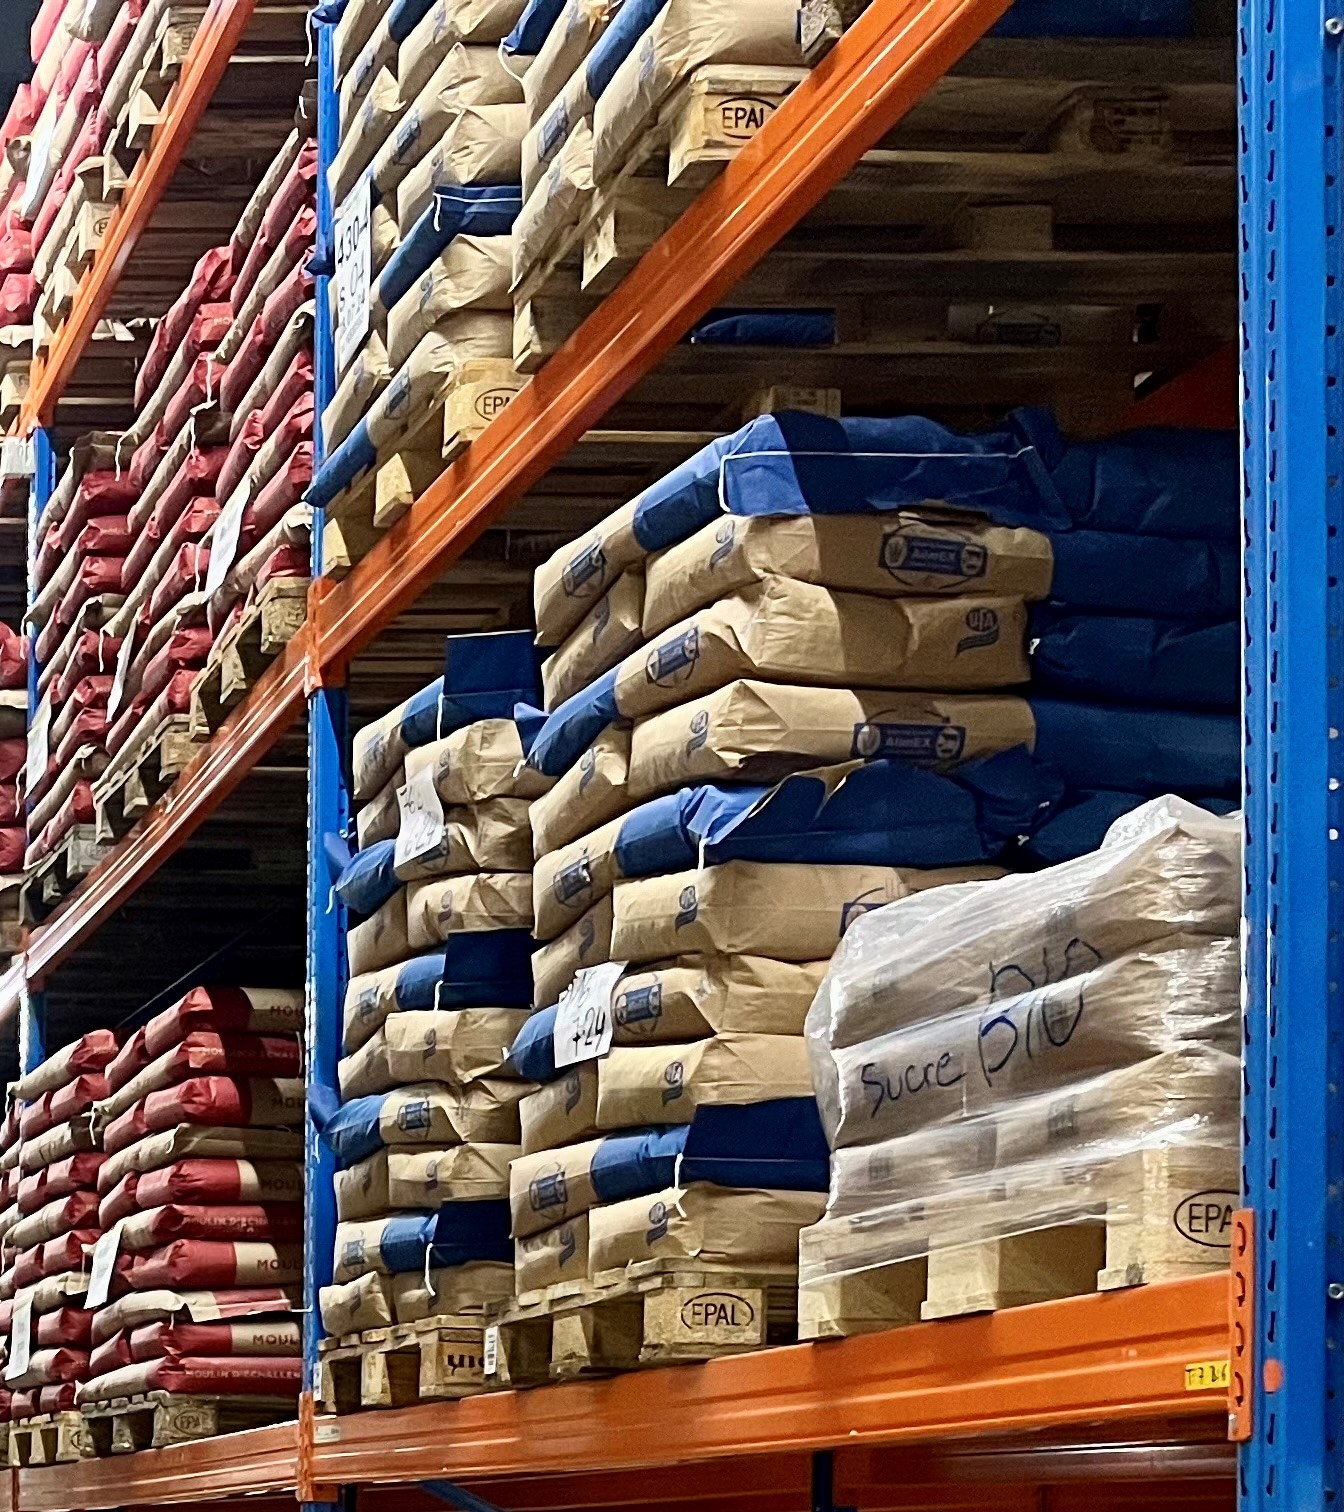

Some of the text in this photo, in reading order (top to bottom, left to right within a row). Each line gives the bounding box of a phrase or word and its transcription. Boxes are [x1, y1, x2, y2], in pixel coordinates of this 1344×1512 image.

[861, 1050, 967, 1118] Sucre
[1188, 1203, 1233, 1233] EPA
[691, 1302, 742, 1328] EPAL
